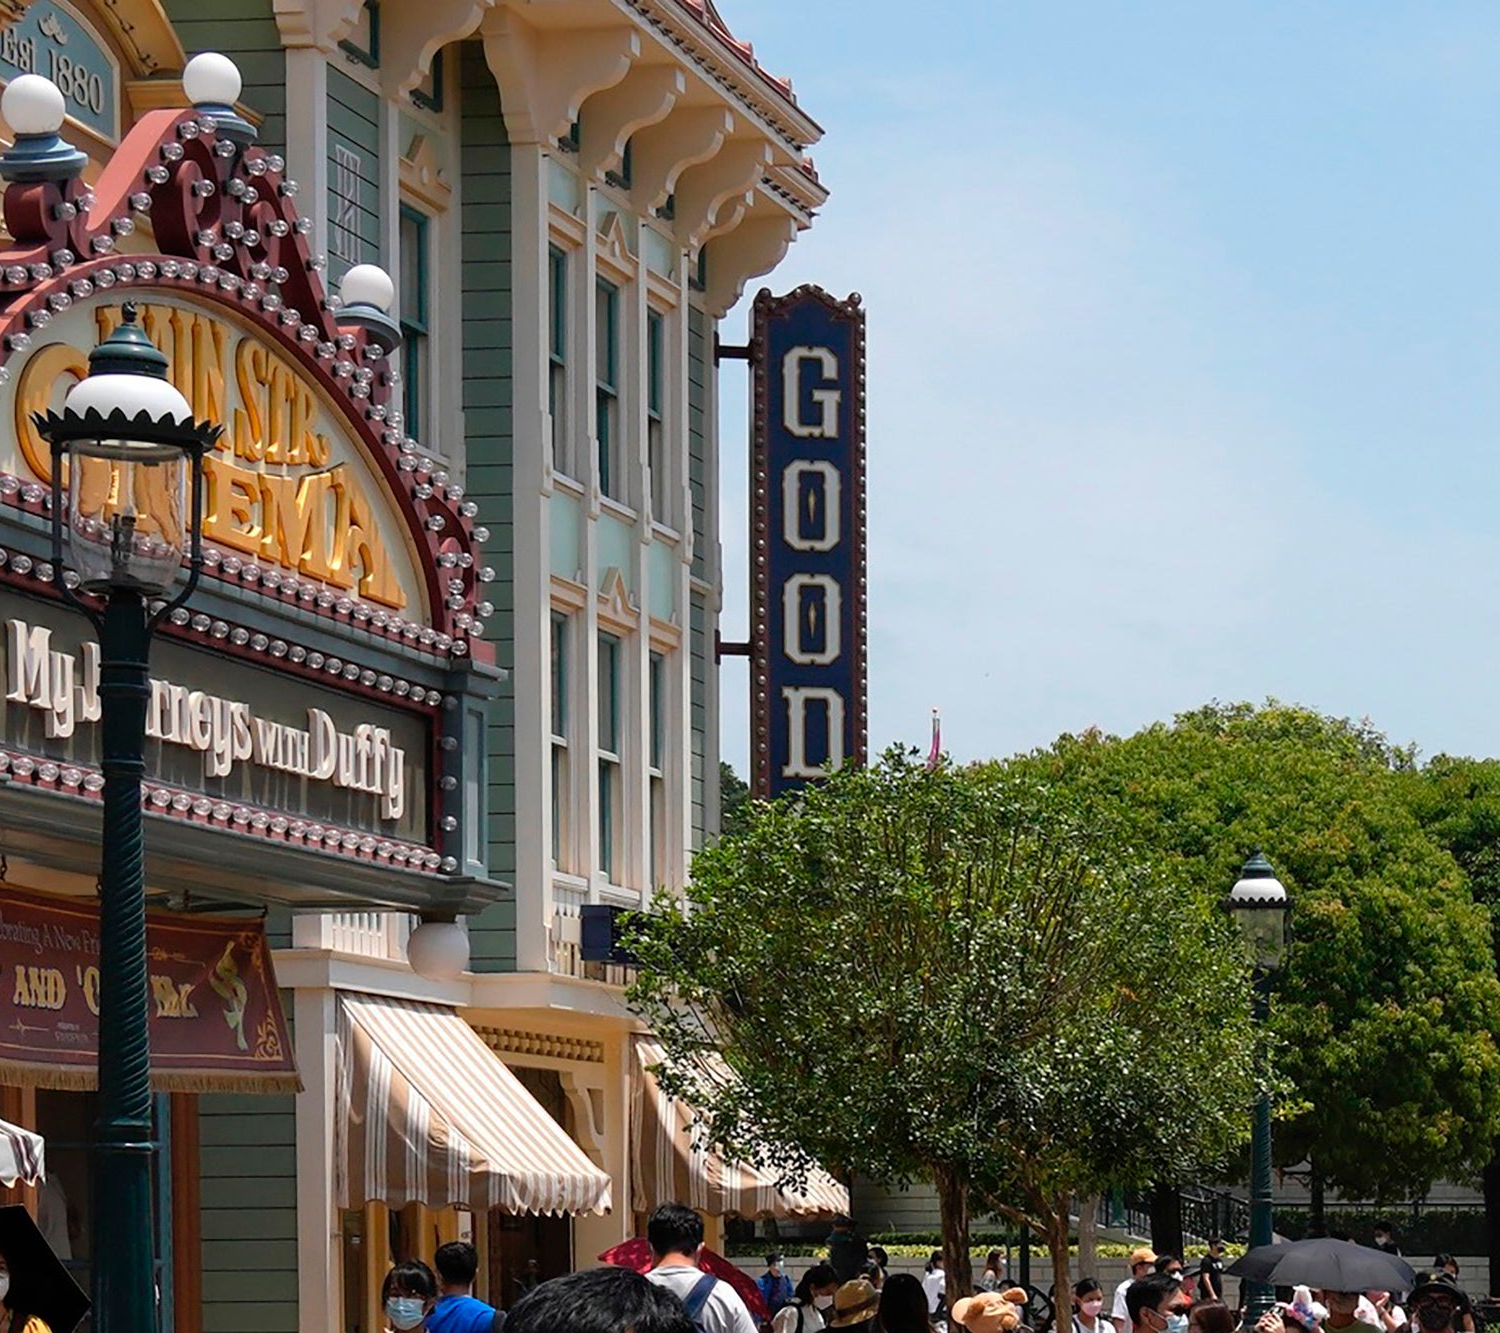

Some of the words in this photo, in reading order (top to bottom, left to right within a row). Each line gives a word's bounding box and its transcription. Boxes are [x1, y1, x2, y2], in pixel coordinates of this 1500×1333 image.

[48, 48, 105, 115] 1880
[781, 344, 847, 779] GOOD
[6, 618, 76, 739] My
[74, 641, 254, 778] Jrneys
[250, 716, 311, 777] WITH
[306, 707, 406, 820] Duffy
[13, 964, 67, 1011] AND
